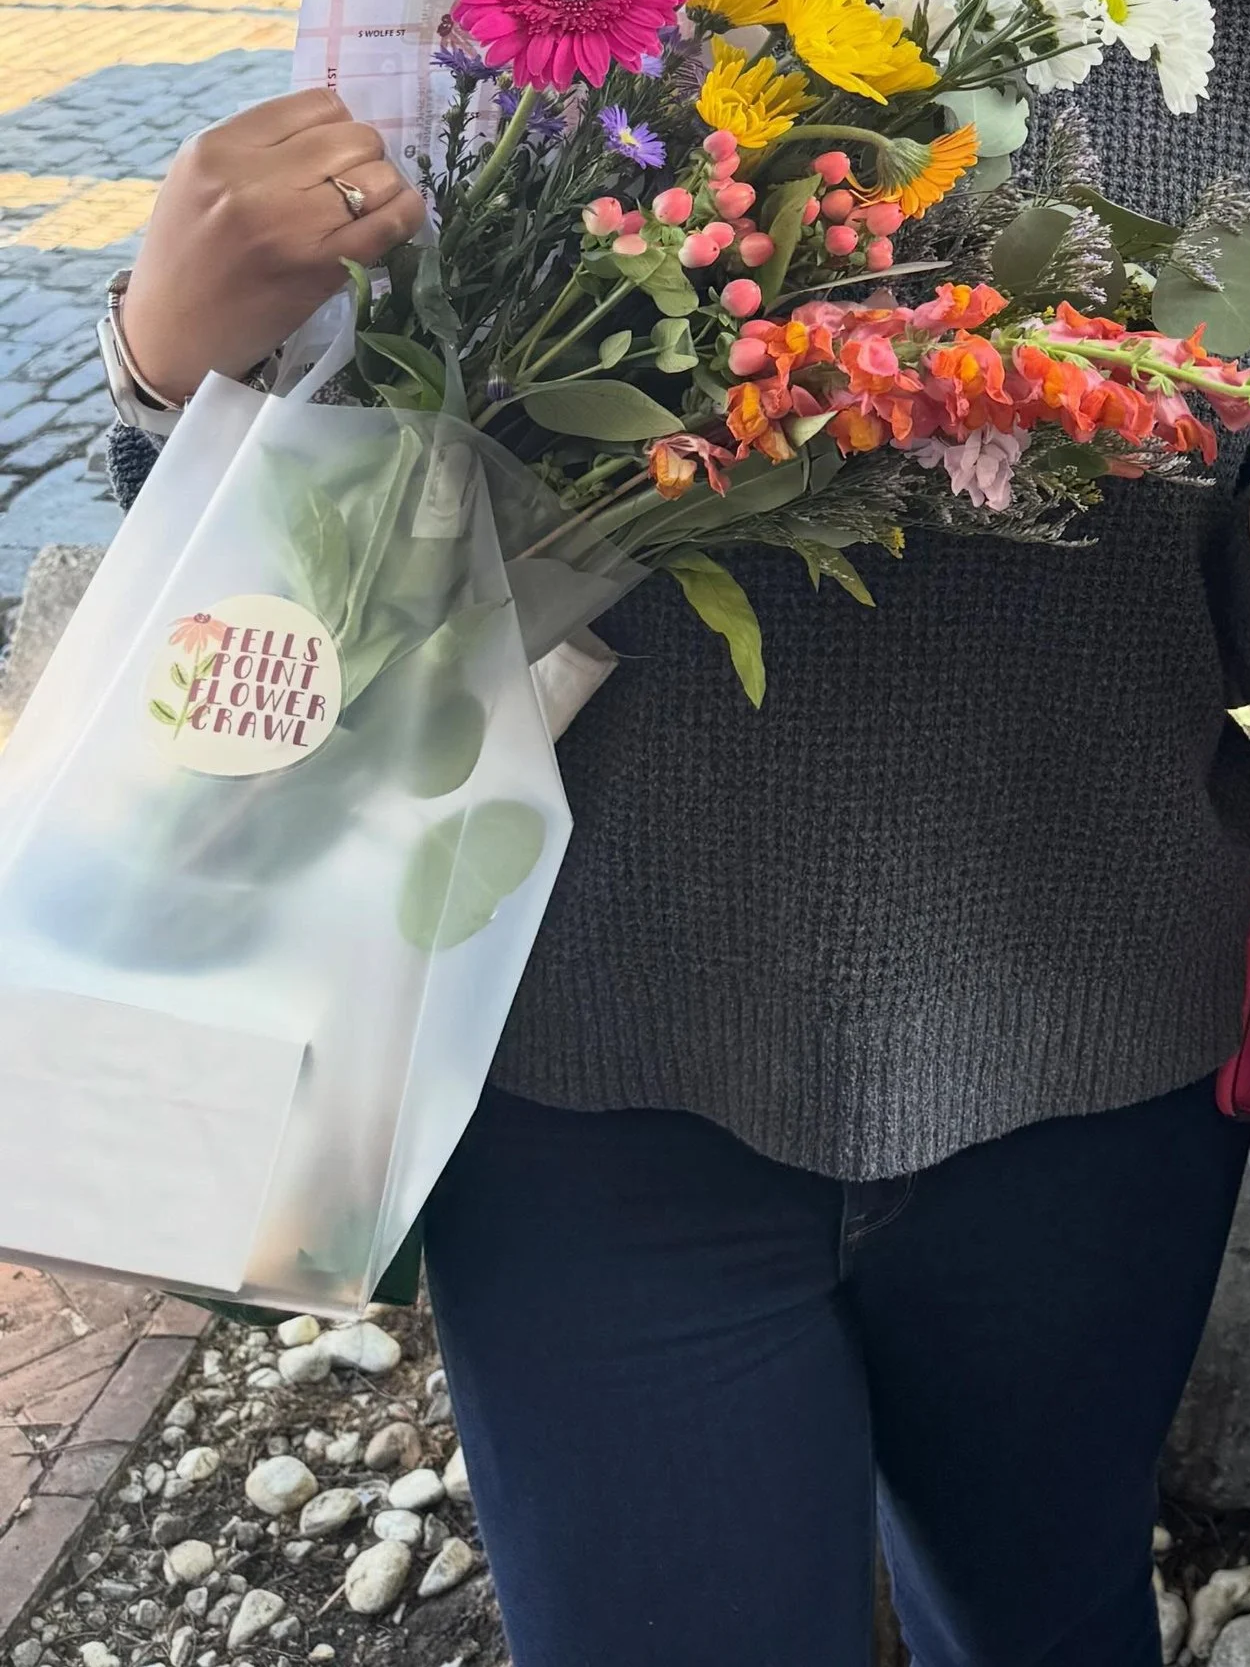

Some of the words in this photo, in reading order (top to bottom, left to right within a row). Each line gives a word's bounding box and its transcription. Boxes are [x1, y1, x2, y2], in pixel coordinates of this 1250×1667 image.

[365, 29, 395, 38] WOLFE
[220, 626, 322, 662] FELLS
[211, 652, 319, 690] POINT
[188, 679, 327, 721] FLOWER
[191, 704, 309, 747] CRAWL
